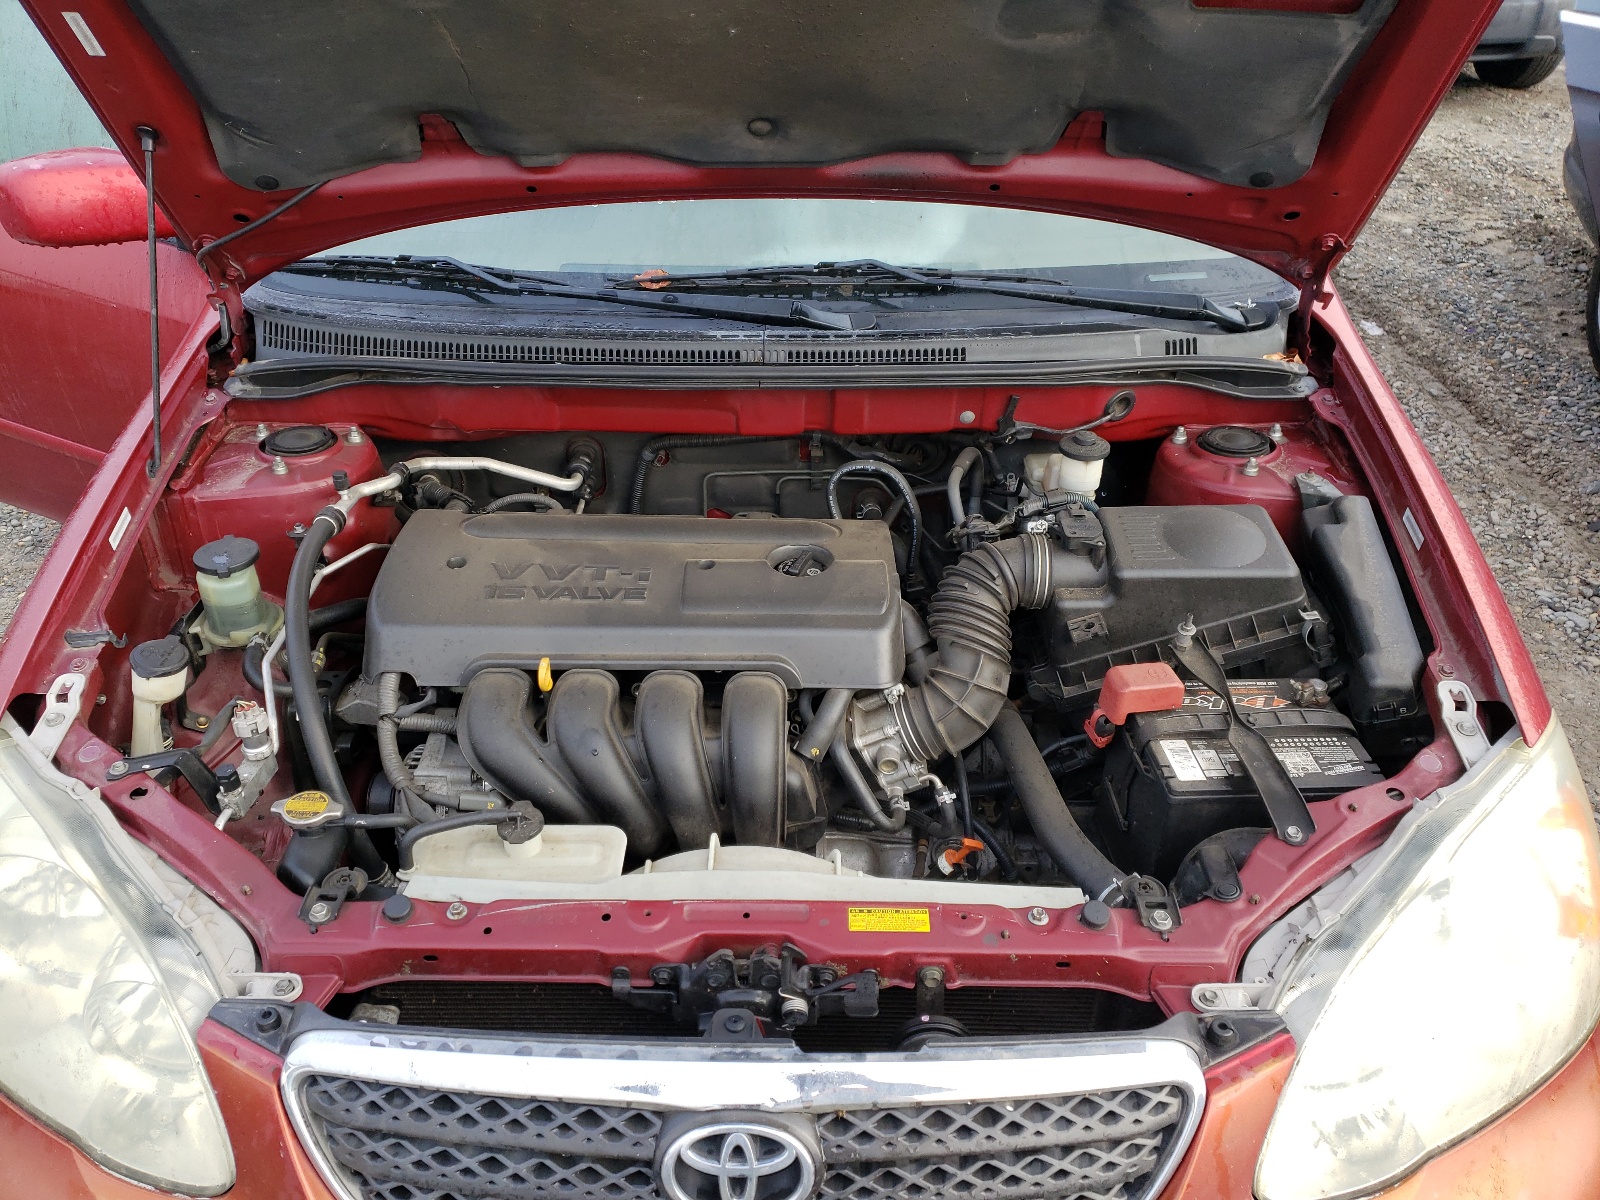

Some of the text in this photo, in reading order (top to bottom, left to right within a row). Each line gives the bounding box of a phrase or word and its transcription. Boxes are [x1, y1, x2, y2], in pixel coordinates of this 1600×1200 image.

[490, 562, 652, 585] VVT-i
[484, 585, 648, 602] 16 VALVE
